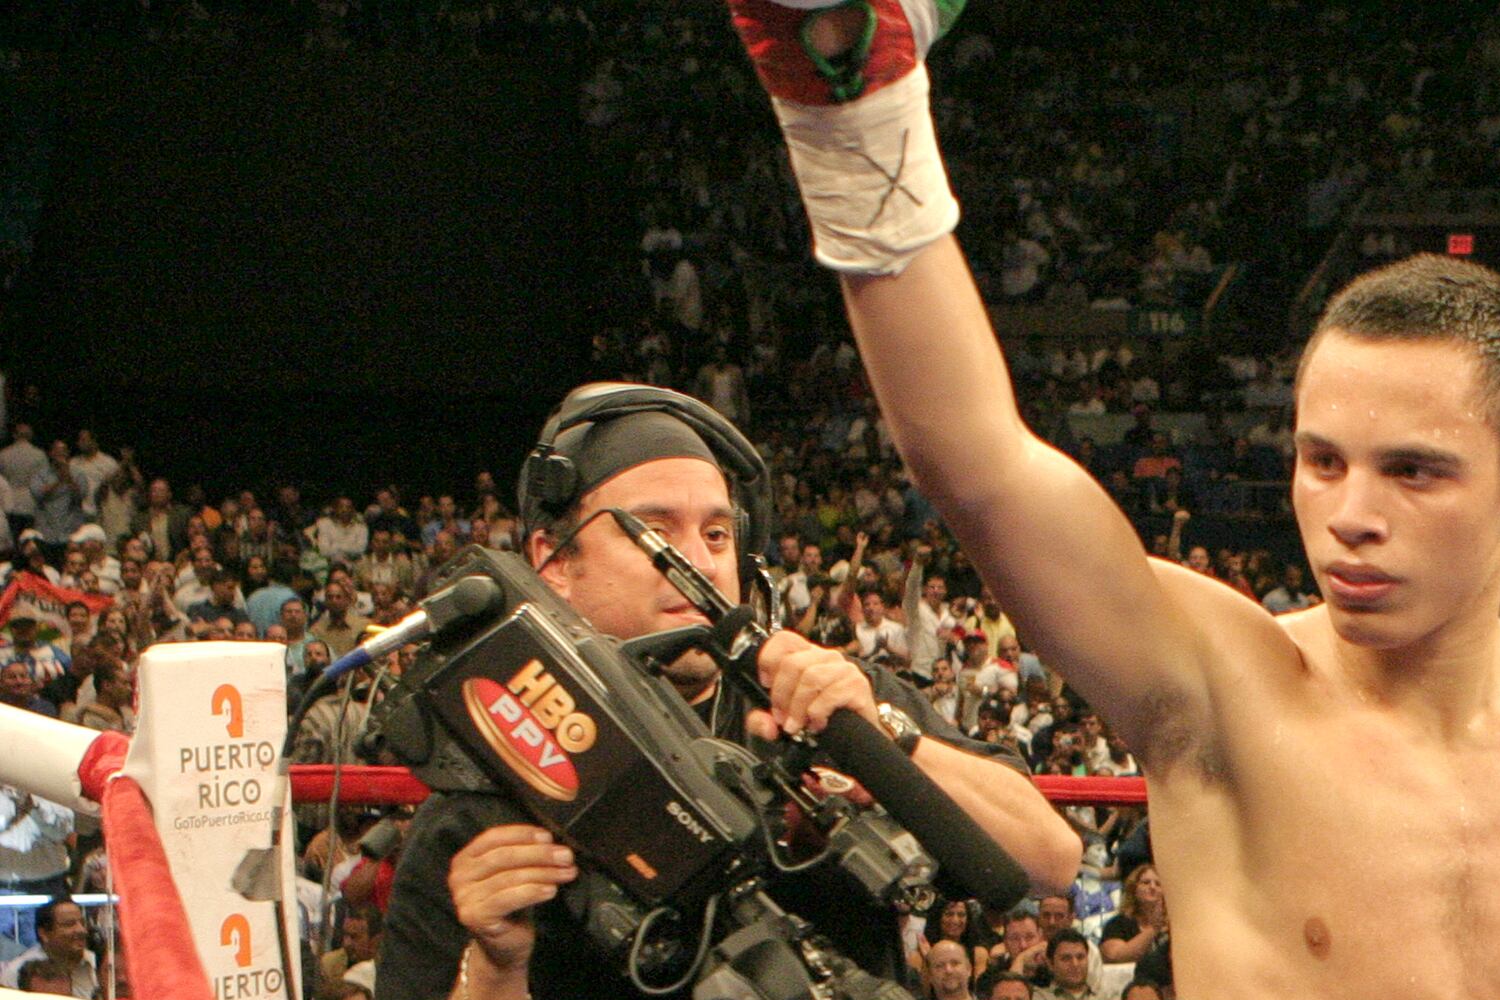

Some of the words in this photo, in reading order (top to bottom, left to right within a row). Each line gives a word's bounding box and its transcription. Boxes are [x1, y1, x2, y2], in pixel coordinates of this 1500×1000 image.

[488, 693, 567, 769] PPV
[506, 659, 597, 753] HBO
[179, 741, 275, 774] PUERTO
[665, 801, 715, 844] SONY
